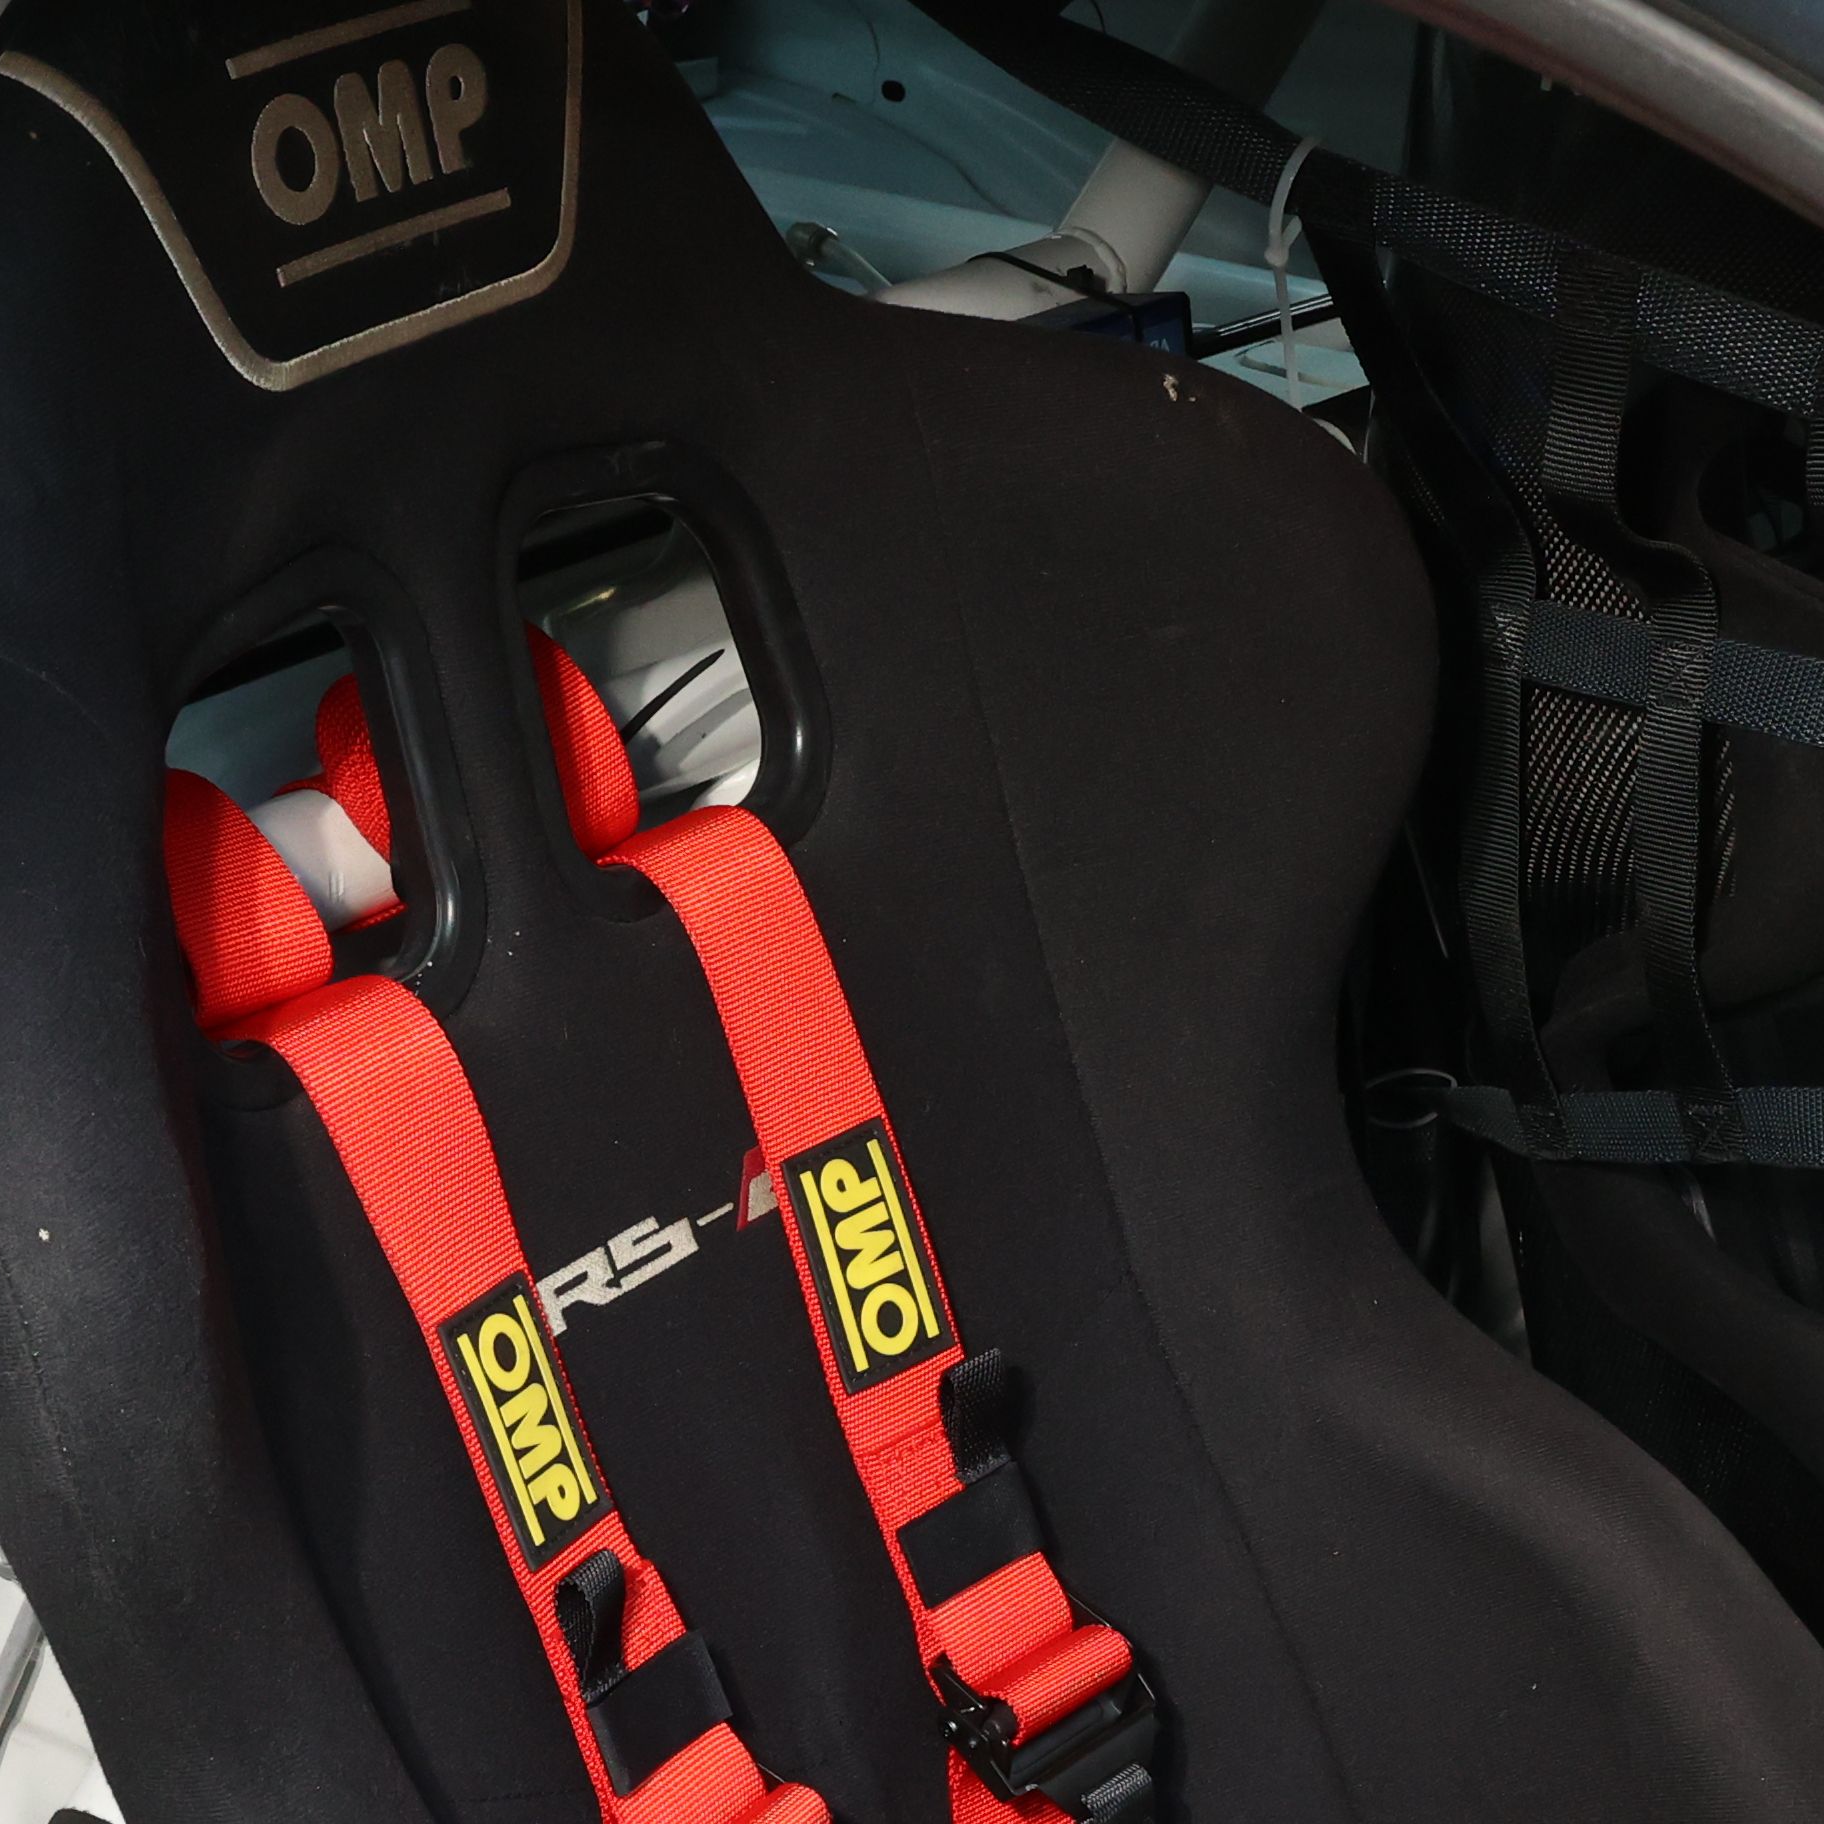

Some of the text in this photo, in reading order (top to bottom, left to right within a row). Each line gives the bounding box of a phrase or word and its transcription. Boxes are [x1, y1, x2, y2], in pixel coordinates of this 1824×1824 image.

[251, 42, 488, 227] OMP
[820, 1157, 920, 1356] OMP
[478, 1310, 582, 1522] OMP
